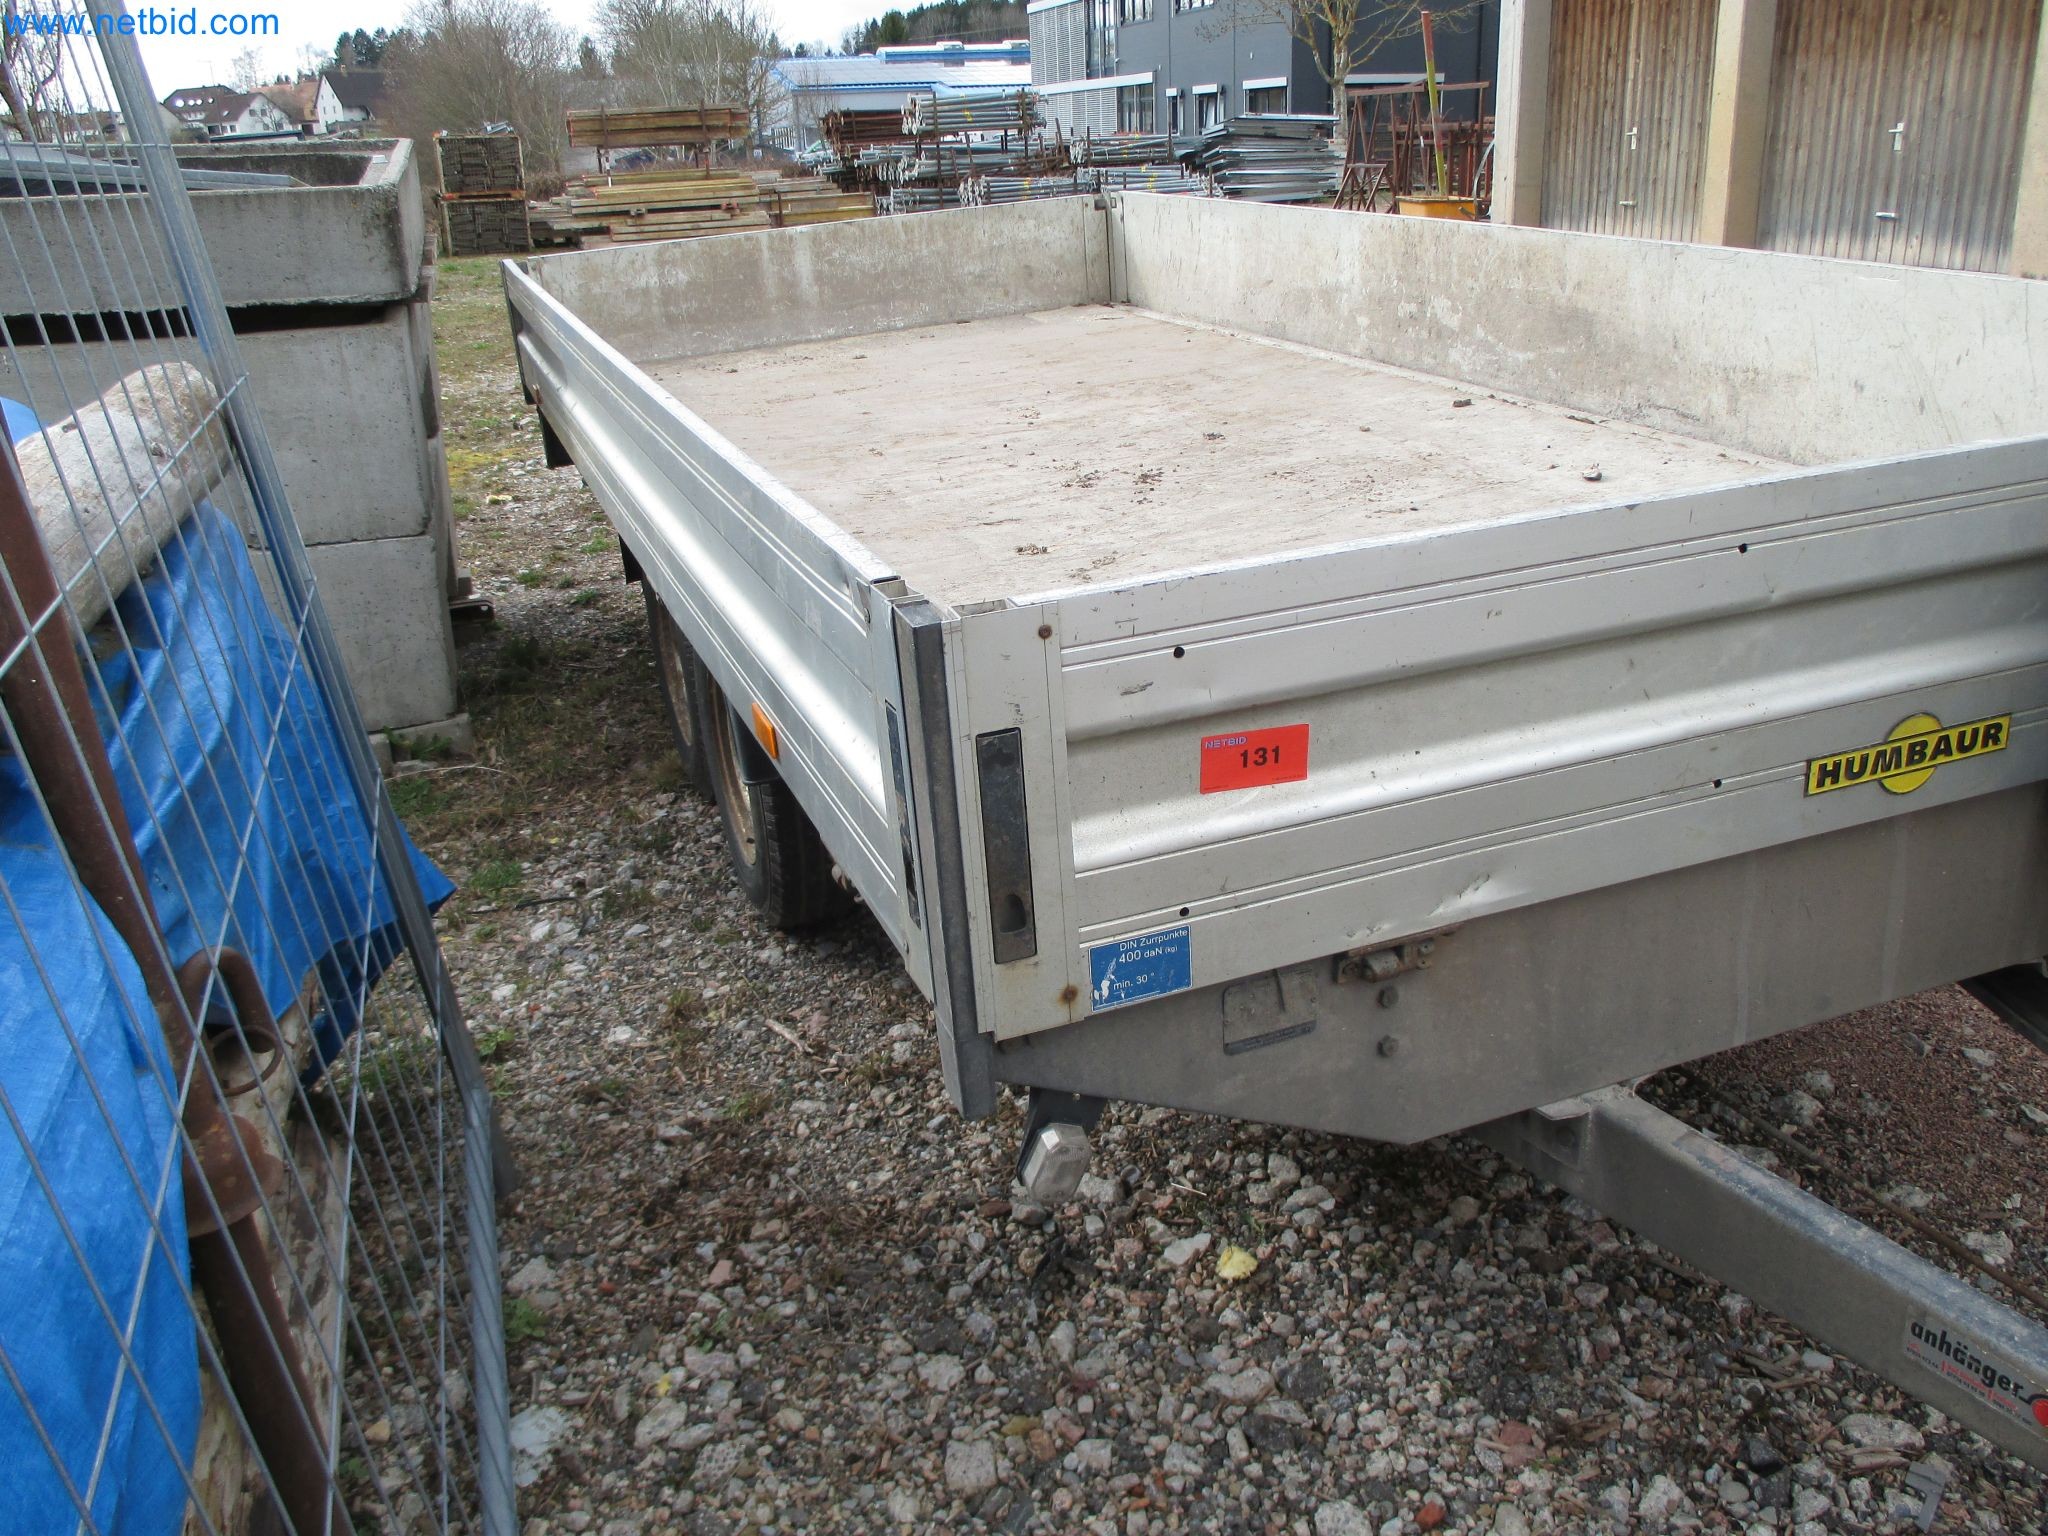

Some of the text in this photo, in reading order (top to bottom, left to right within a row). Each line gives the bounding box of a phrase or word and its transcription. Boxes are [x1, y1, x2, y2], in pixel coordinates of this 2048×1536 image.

[1205, 736, 1248, 749] NETBID
[1240, 745, 1280, 768] 131
[1815, 721, 2004, 788] HUMBAUR
[1119, 929, 1188, 951] DIN Zurrpunkte
[1119, 945, 1178, 963] 400 daN (kg)
[1113, 980, 1134, 991] min.
[1136, 974, 1148, 985] 30
[1910, 1321, 2024, 1398] anhänger
